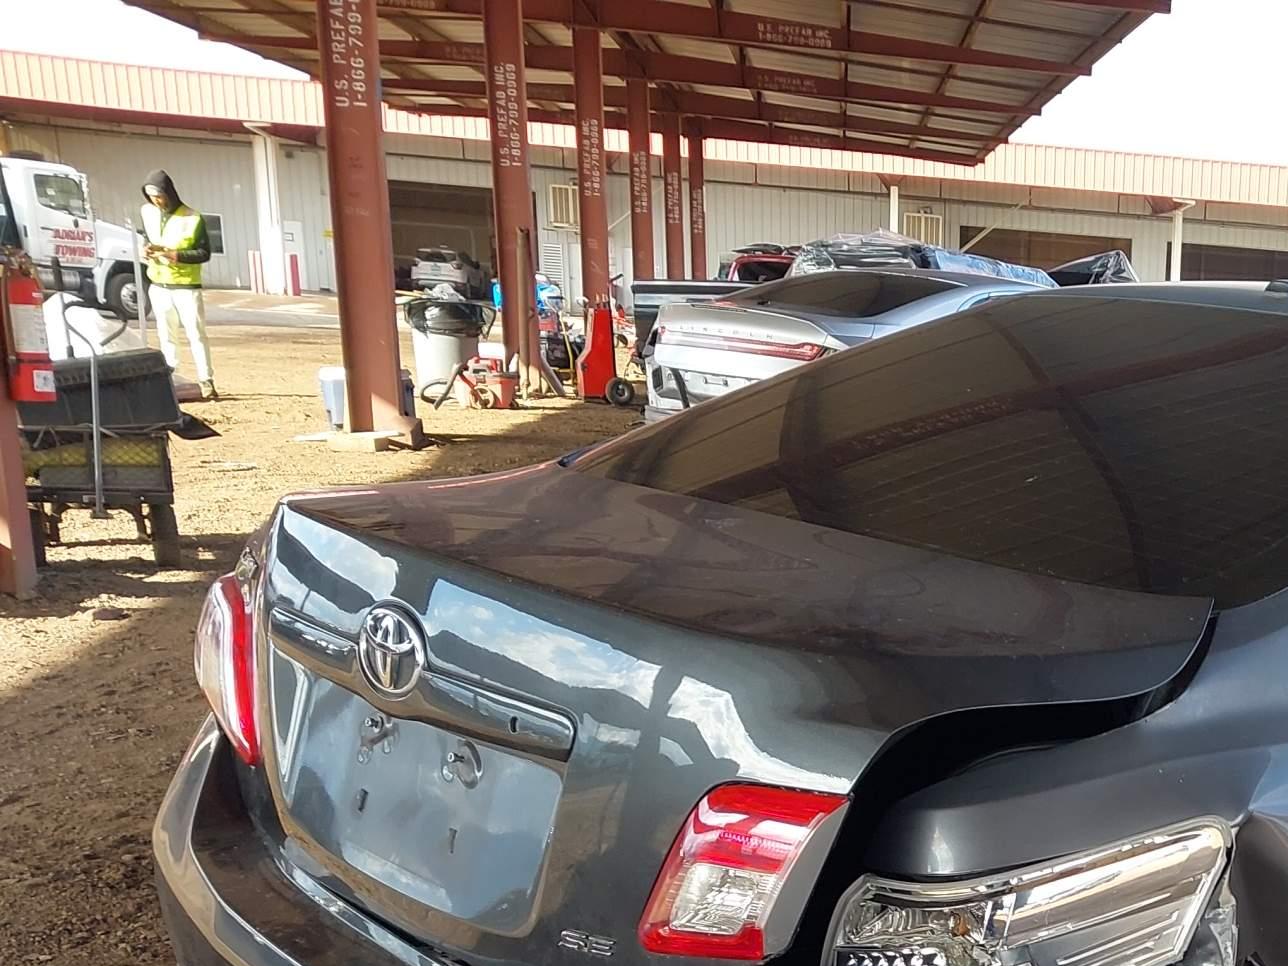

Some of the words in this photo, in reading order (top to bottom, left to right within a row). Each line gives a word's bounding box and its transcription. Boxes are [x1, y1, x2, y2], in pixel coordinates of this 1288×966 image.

[334, 73, 350, 107] U.S.
[495, 91, 508, 138] PREFAB
[55, 244, 96, 258] TOWING
[557, 928, 617, 958] SE
